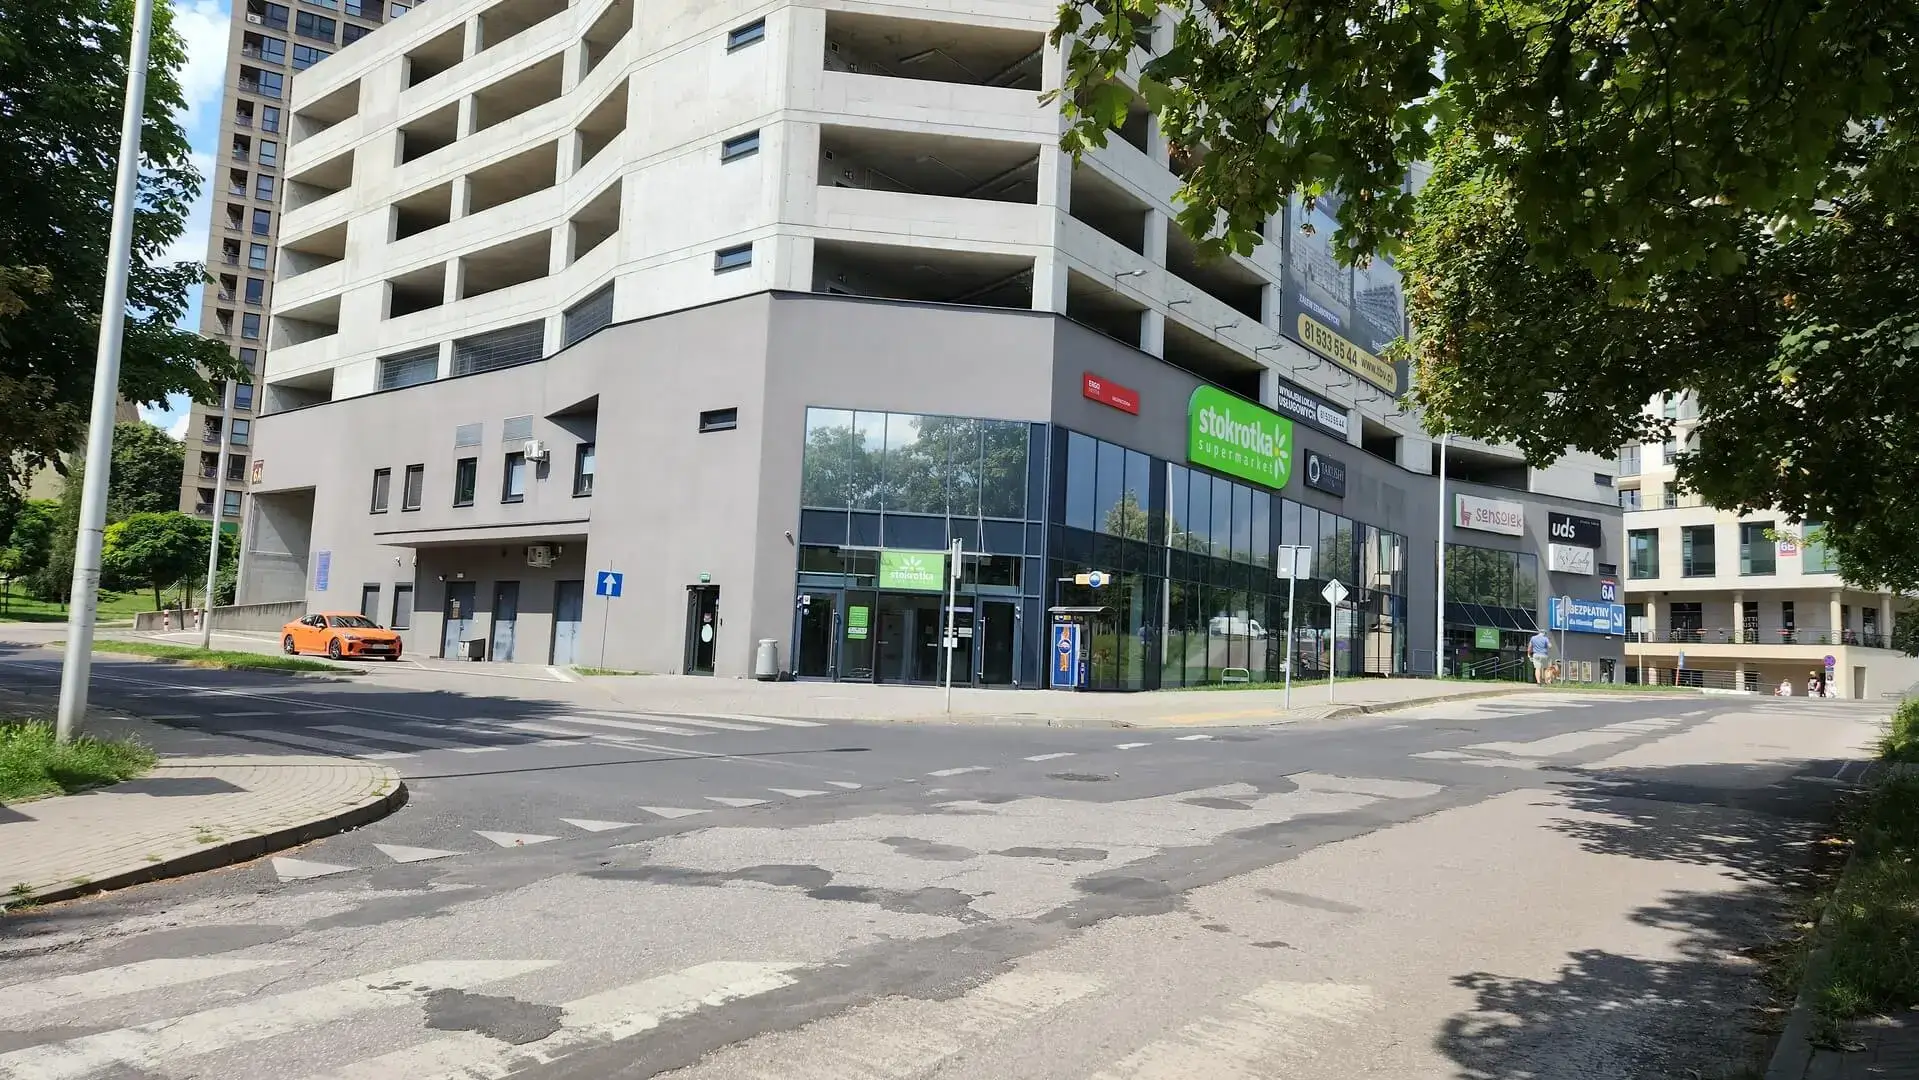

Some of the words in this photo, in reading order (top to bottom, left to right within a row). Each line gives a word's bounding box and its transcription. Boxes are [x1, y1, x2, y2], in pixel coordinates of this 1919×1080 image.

[1304, 320, 1314, 343] 81
[1316, 327, 1333, 353] 533
[1334, 338, 1345, 360] 55
[1346, 346, 1358, 368] 44
[1198, 405, 1273, 457] stokrotka
[1198, 439, 1273, 474] supermarket
[1552, 517, 1575, 539] uds
[890, 570, 934, 581] stokrotka
[1601, 584, 1615, 601] 6A
[1569, 604, 1609, 617] BEZPŁATNY
